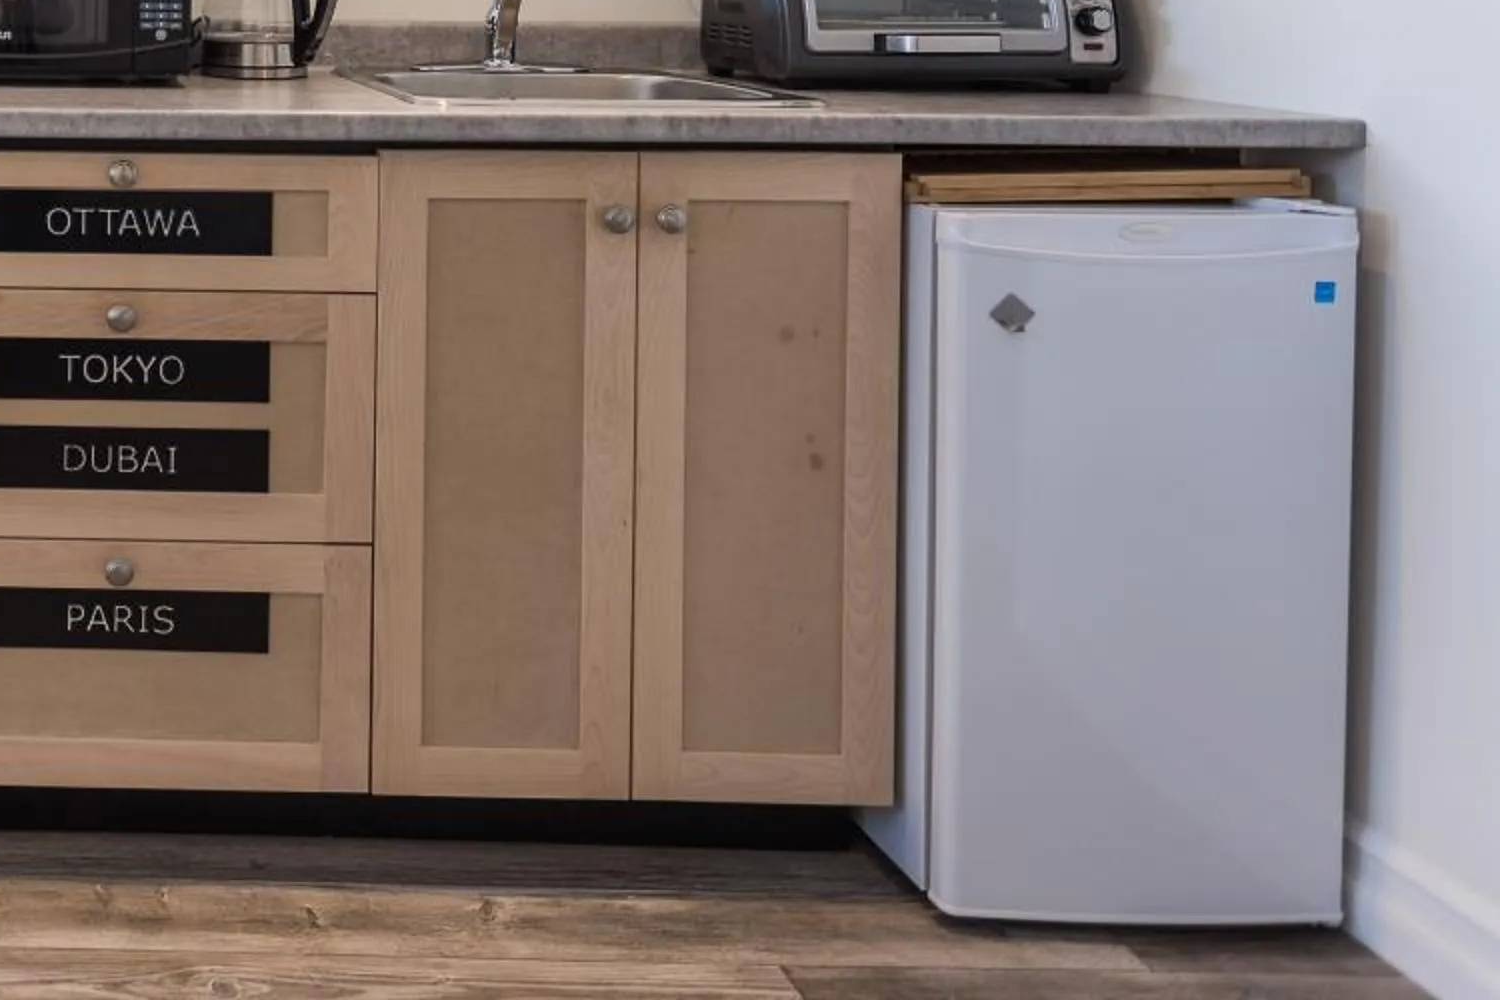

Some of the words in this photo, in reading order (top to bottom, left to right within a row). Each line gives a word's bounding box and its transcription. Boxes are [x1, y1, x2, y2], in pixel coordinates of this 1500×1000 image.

[46, 207, 200, 237] OTTAWA
[58, 354, 186, 385] TOKYO
[62, 444, 179, 474] DUBAI
[66, 603, 176, 635] PARIS
